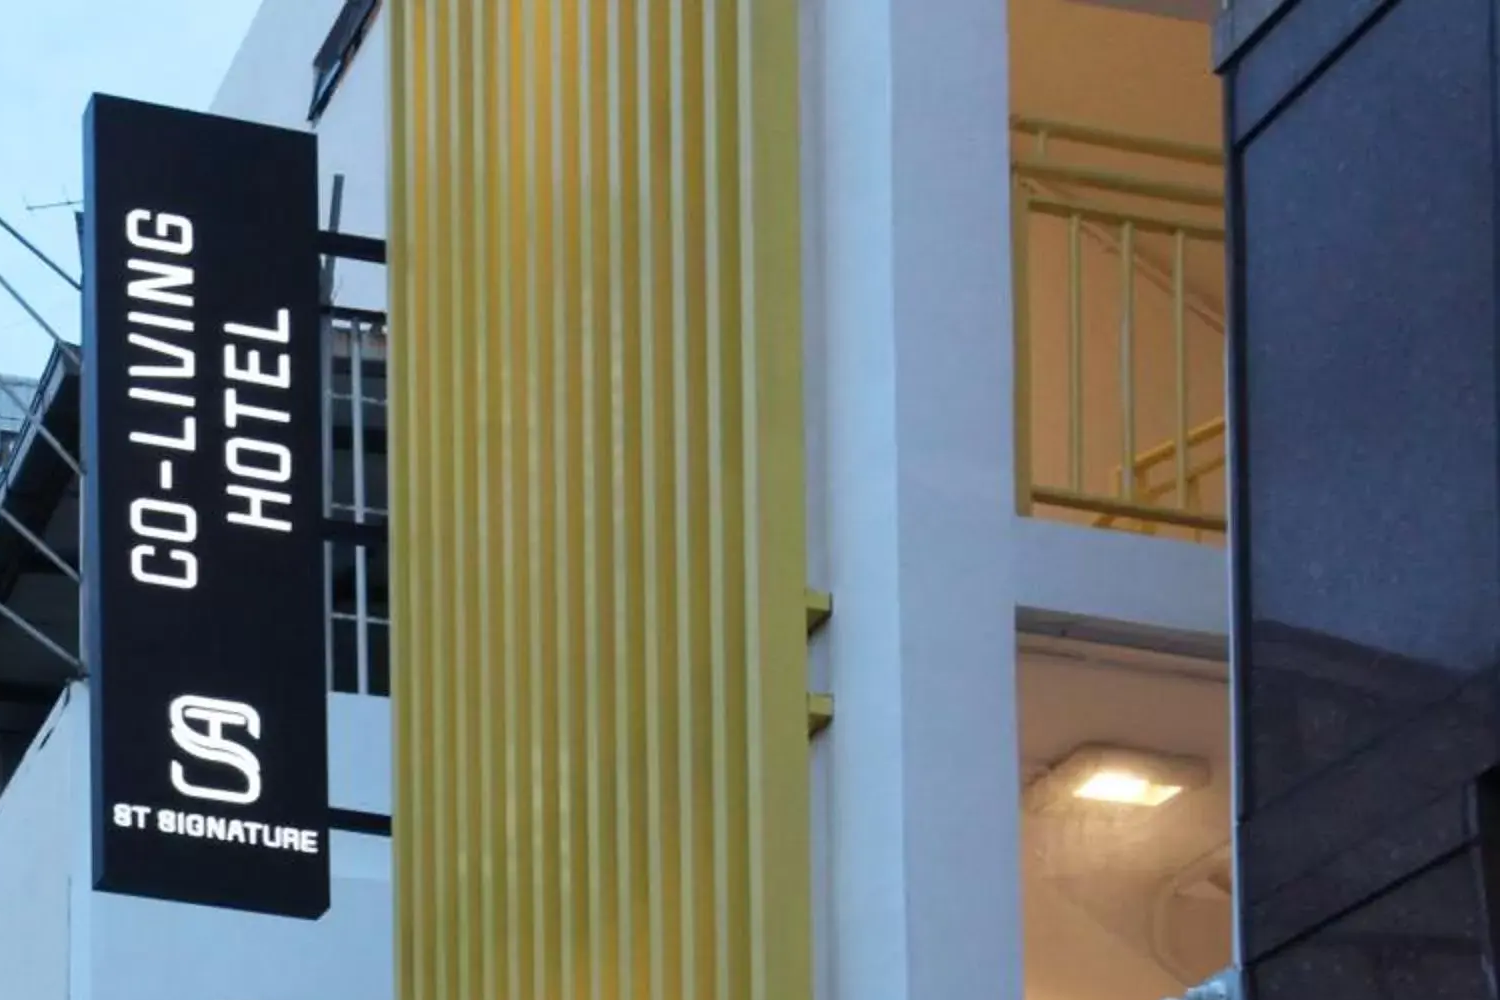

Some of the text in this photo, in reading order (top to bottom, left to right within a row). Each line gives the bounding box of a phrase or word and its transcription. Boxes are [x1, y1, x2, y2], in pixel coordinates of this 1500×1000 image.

[125, 208, 198, 589] CO-LIVING
[223, 308, 293, 532] HOTEL
[113, 803, 319, 854] ST SIGNATURE
